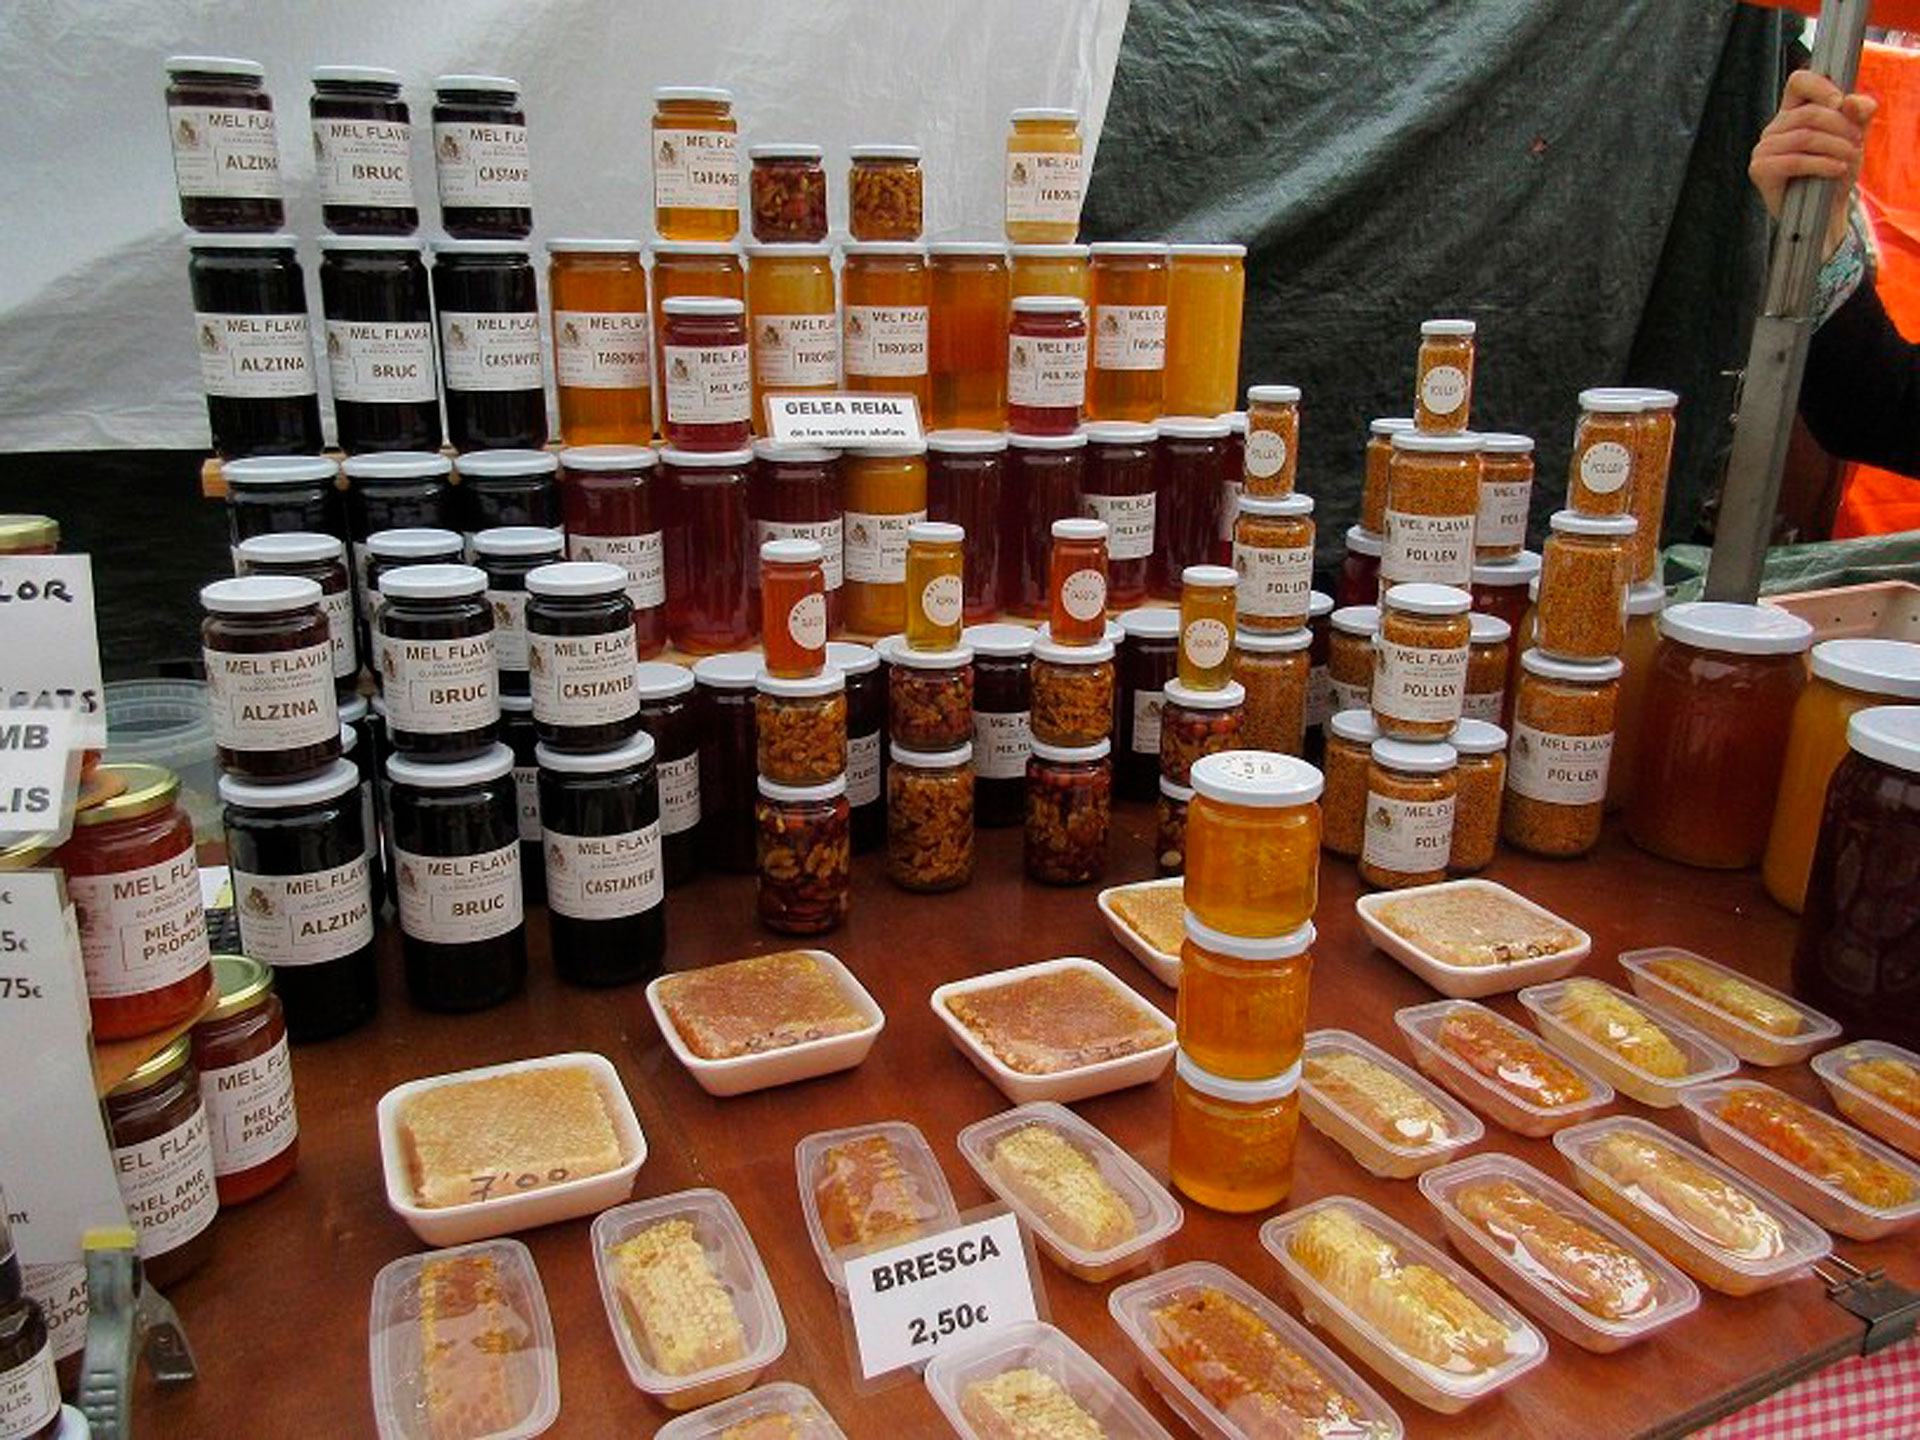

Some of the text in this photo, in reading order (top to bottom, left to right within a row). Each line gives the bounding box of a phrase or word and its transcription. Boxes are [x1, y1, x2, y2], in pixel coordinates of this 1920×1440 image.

[209, 114, 244, 128] MEL
[331, 125, 360, 139] MEL
[470, 128, 501, 142] MEL
[352, 165, 404, 181] BRUC
[227, 320, 260, 333] MEL
[477, 318, 507, 331] MEL
[590, 317, 618, 330] MEL
[351, 328, 381, 340] MEL
[241, 357, 305, 372] ALZINA
[371, 364, 417, 379] BRUC
[785, 402, 902, 415] GELEA REIAL
[406, 646, 442, 660] MEL
[554, 642, 589, 656] MEL
[225, 660, 264, 675] MEL
[430, 682, 487, 704] BRUC
[242, 699, 318, 720] ALZINA
[578, 842, 612, 855] MEL
[427, 862, 464, 876] MEL
[113, 874, 166, 899] MEL
[286, 877, 326, 895] MEL
[452, 893, 505, 916] BRUC
[301, 902, 368, 937] ALZINA
[145, 920, 179, 941] MEL
[218, 1067, 264, 1092] MEL
[243, 1105, 276, 1127] MEL
[113, 1152, 152, 1174] EL
[872, 1235, 1001, 1292] BRESCA
[908, 1303, 989, 1346] 2,50€
